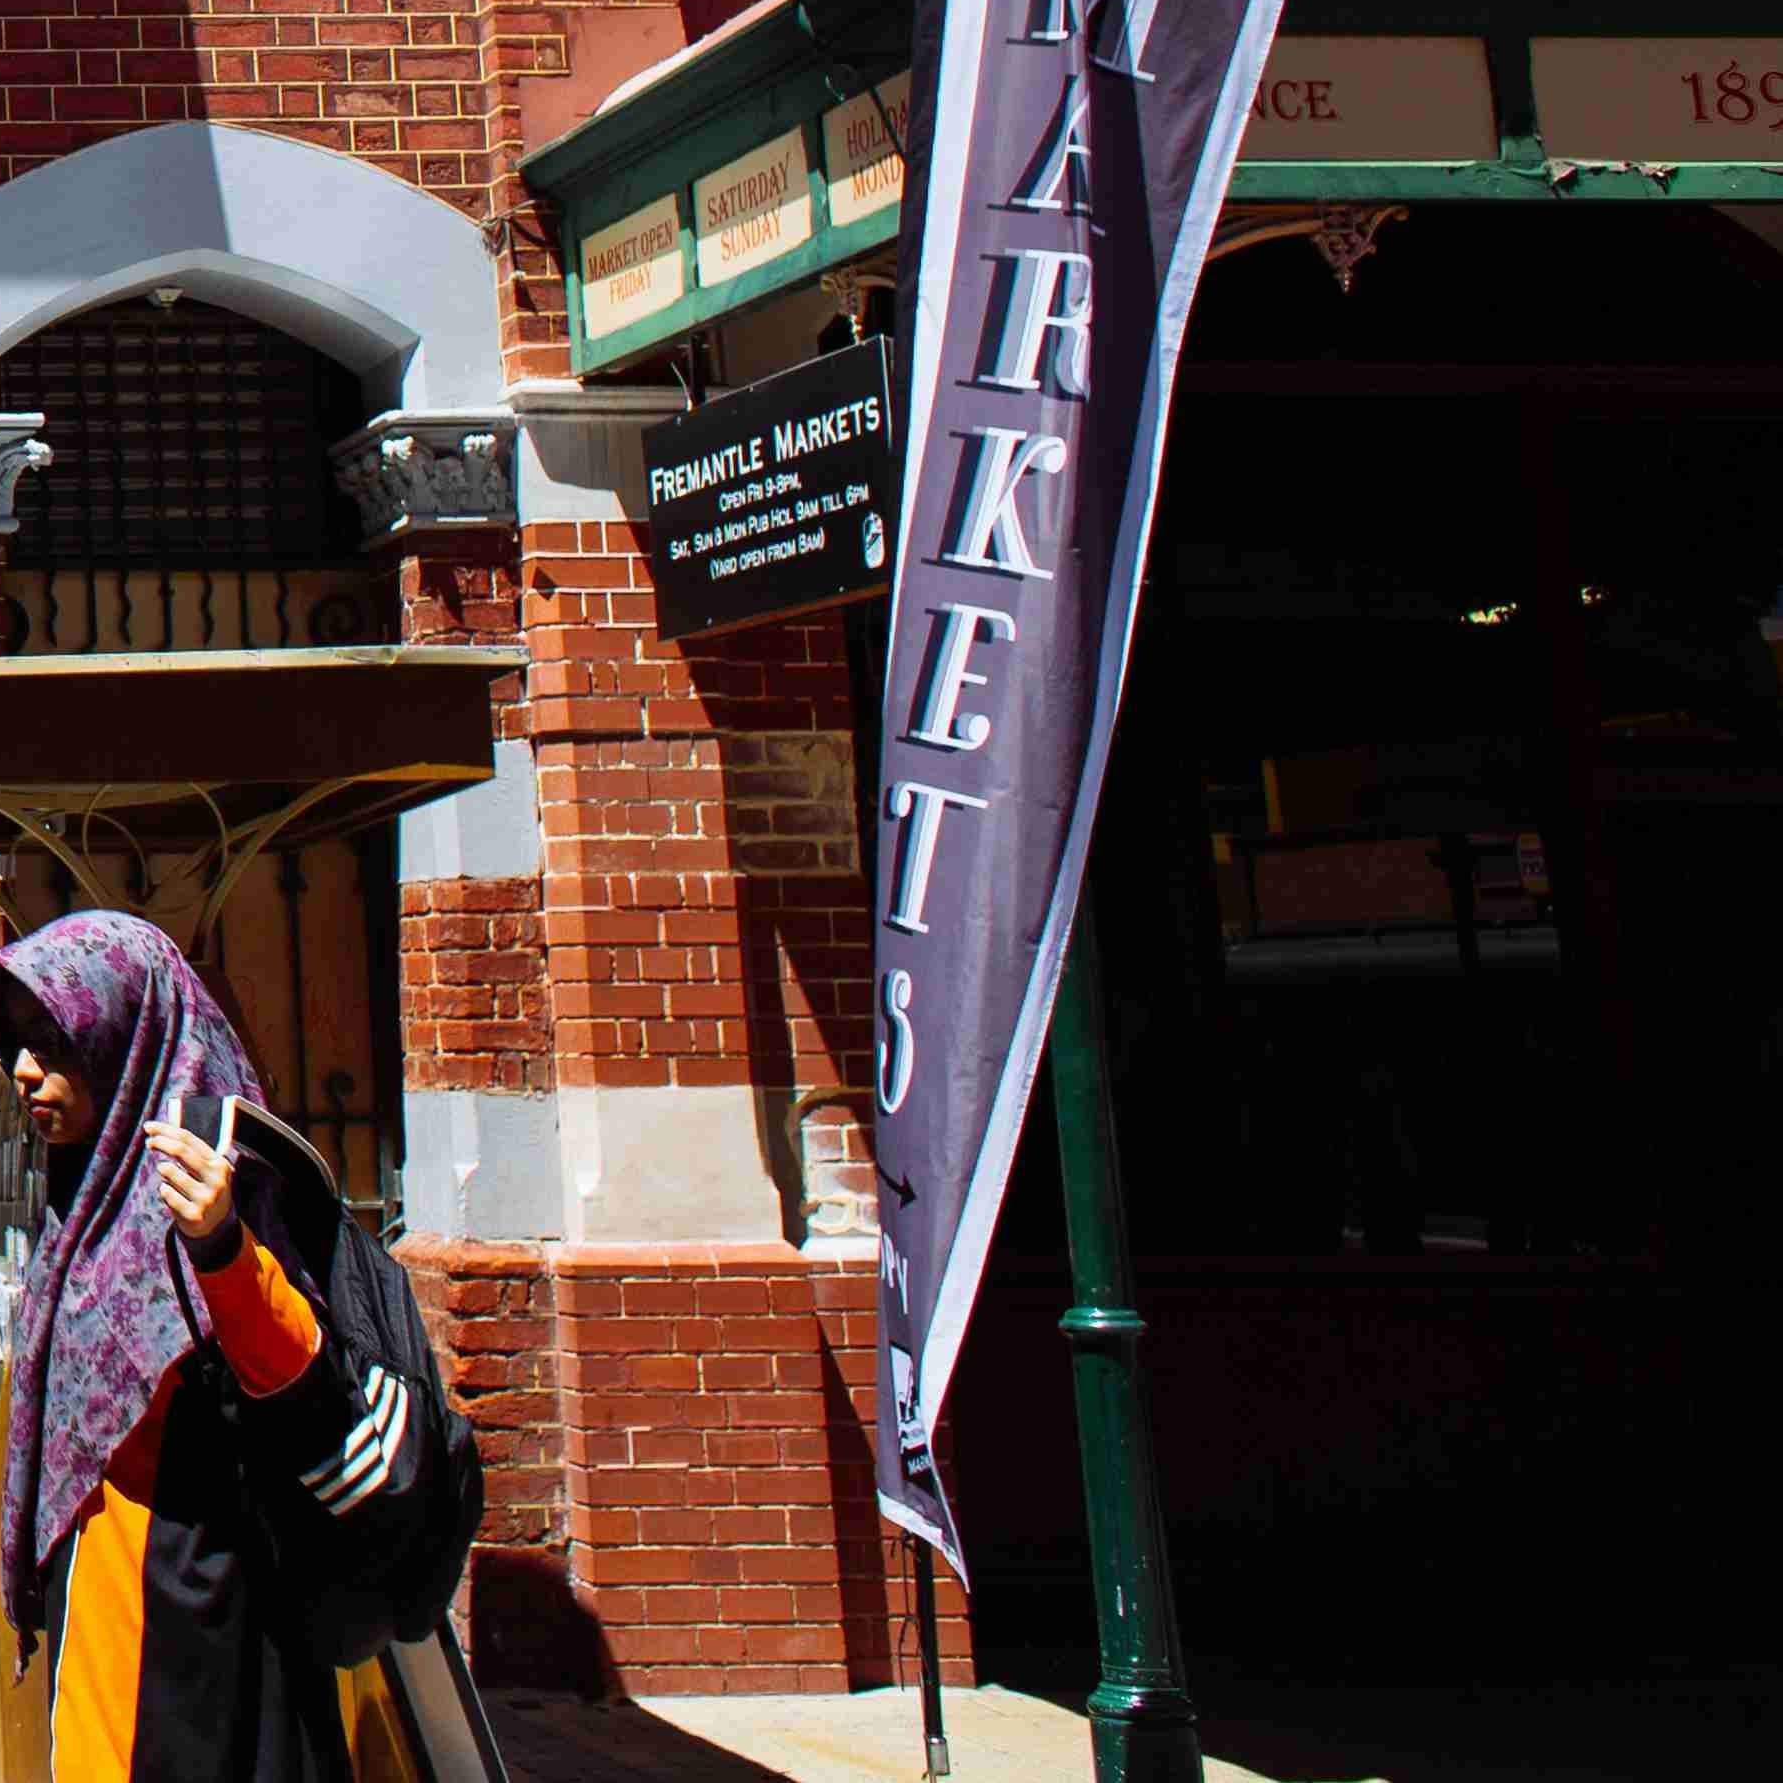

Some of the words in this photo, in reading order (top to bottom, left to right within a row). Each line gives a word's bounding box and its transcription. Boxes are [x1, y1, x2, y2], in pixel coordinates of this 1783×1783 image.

[707, 152, 793, 228] SATURDAY
[587, 237, 638, 282] MARKET
[639, 219, 674, 257] OPEN
[720, 203, 783, 262] SUNDAY
[608, 259, 653, 305] FRIDAY
[650, 437, 764, 505] FREMANTLE
[774, 396, 880, 462] MARKETS
[693, 531, 714, 554] SUN
[723, 519, 747, 543] MON
[748, 514, 769, 536] PUB
[770, 507, 794, 531] HOL
[795, 497, 819, 521] 9AM
[821, 492, 844, 516] TILL
[845, 483, 870, 506] 6PM
[719, 489, 745, 512] OPEN
[747, 483, 764, 504] FRI
[709, 555, 737, 582] (YARD
[739, 546, 766, 570] OPEN
[767, 537, 796, 562] FROM
[797, 526, 825, 553] 8AM)
